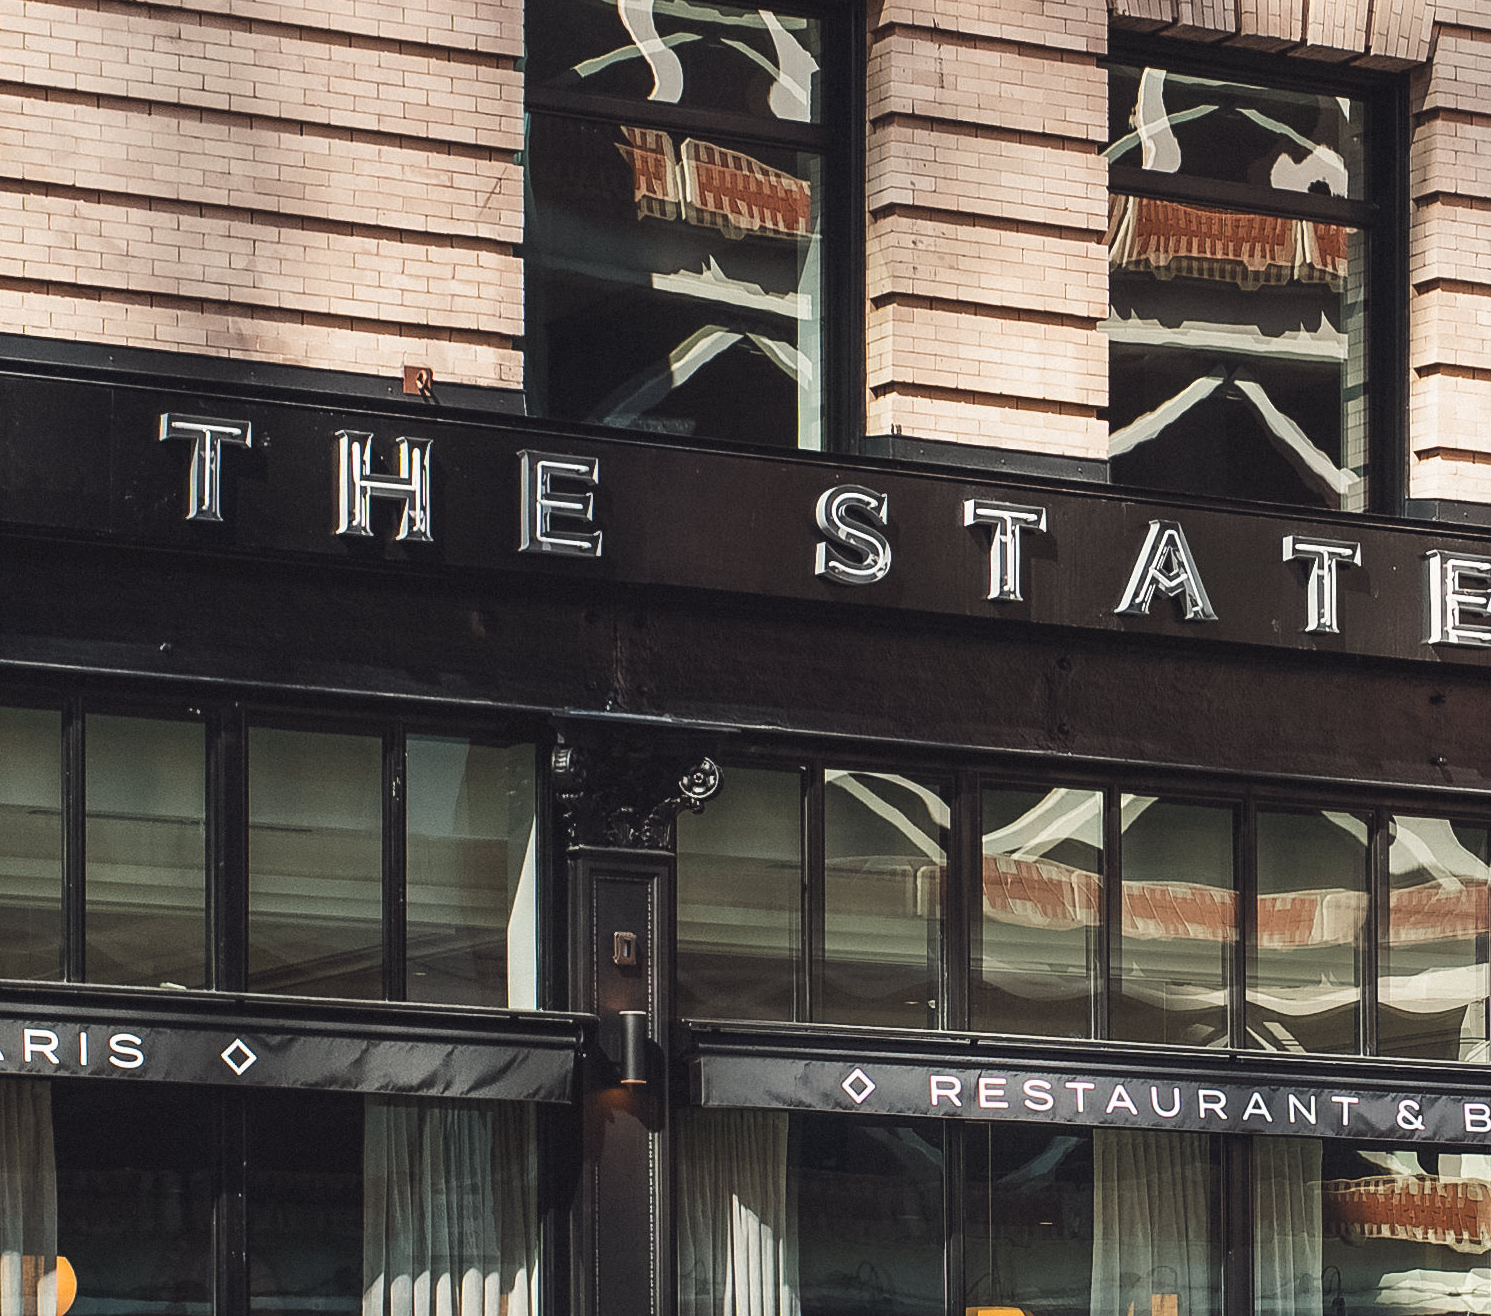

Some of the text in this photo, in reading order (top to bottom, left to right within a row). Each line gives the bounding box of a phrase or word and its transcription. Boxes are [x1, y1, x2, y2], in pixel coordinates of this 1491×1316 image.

[158, 411, 603, 558] THE
[929, 1073, 1352, 1127] RESTAURANT
[1396, 1099, 1425, 1131] &
